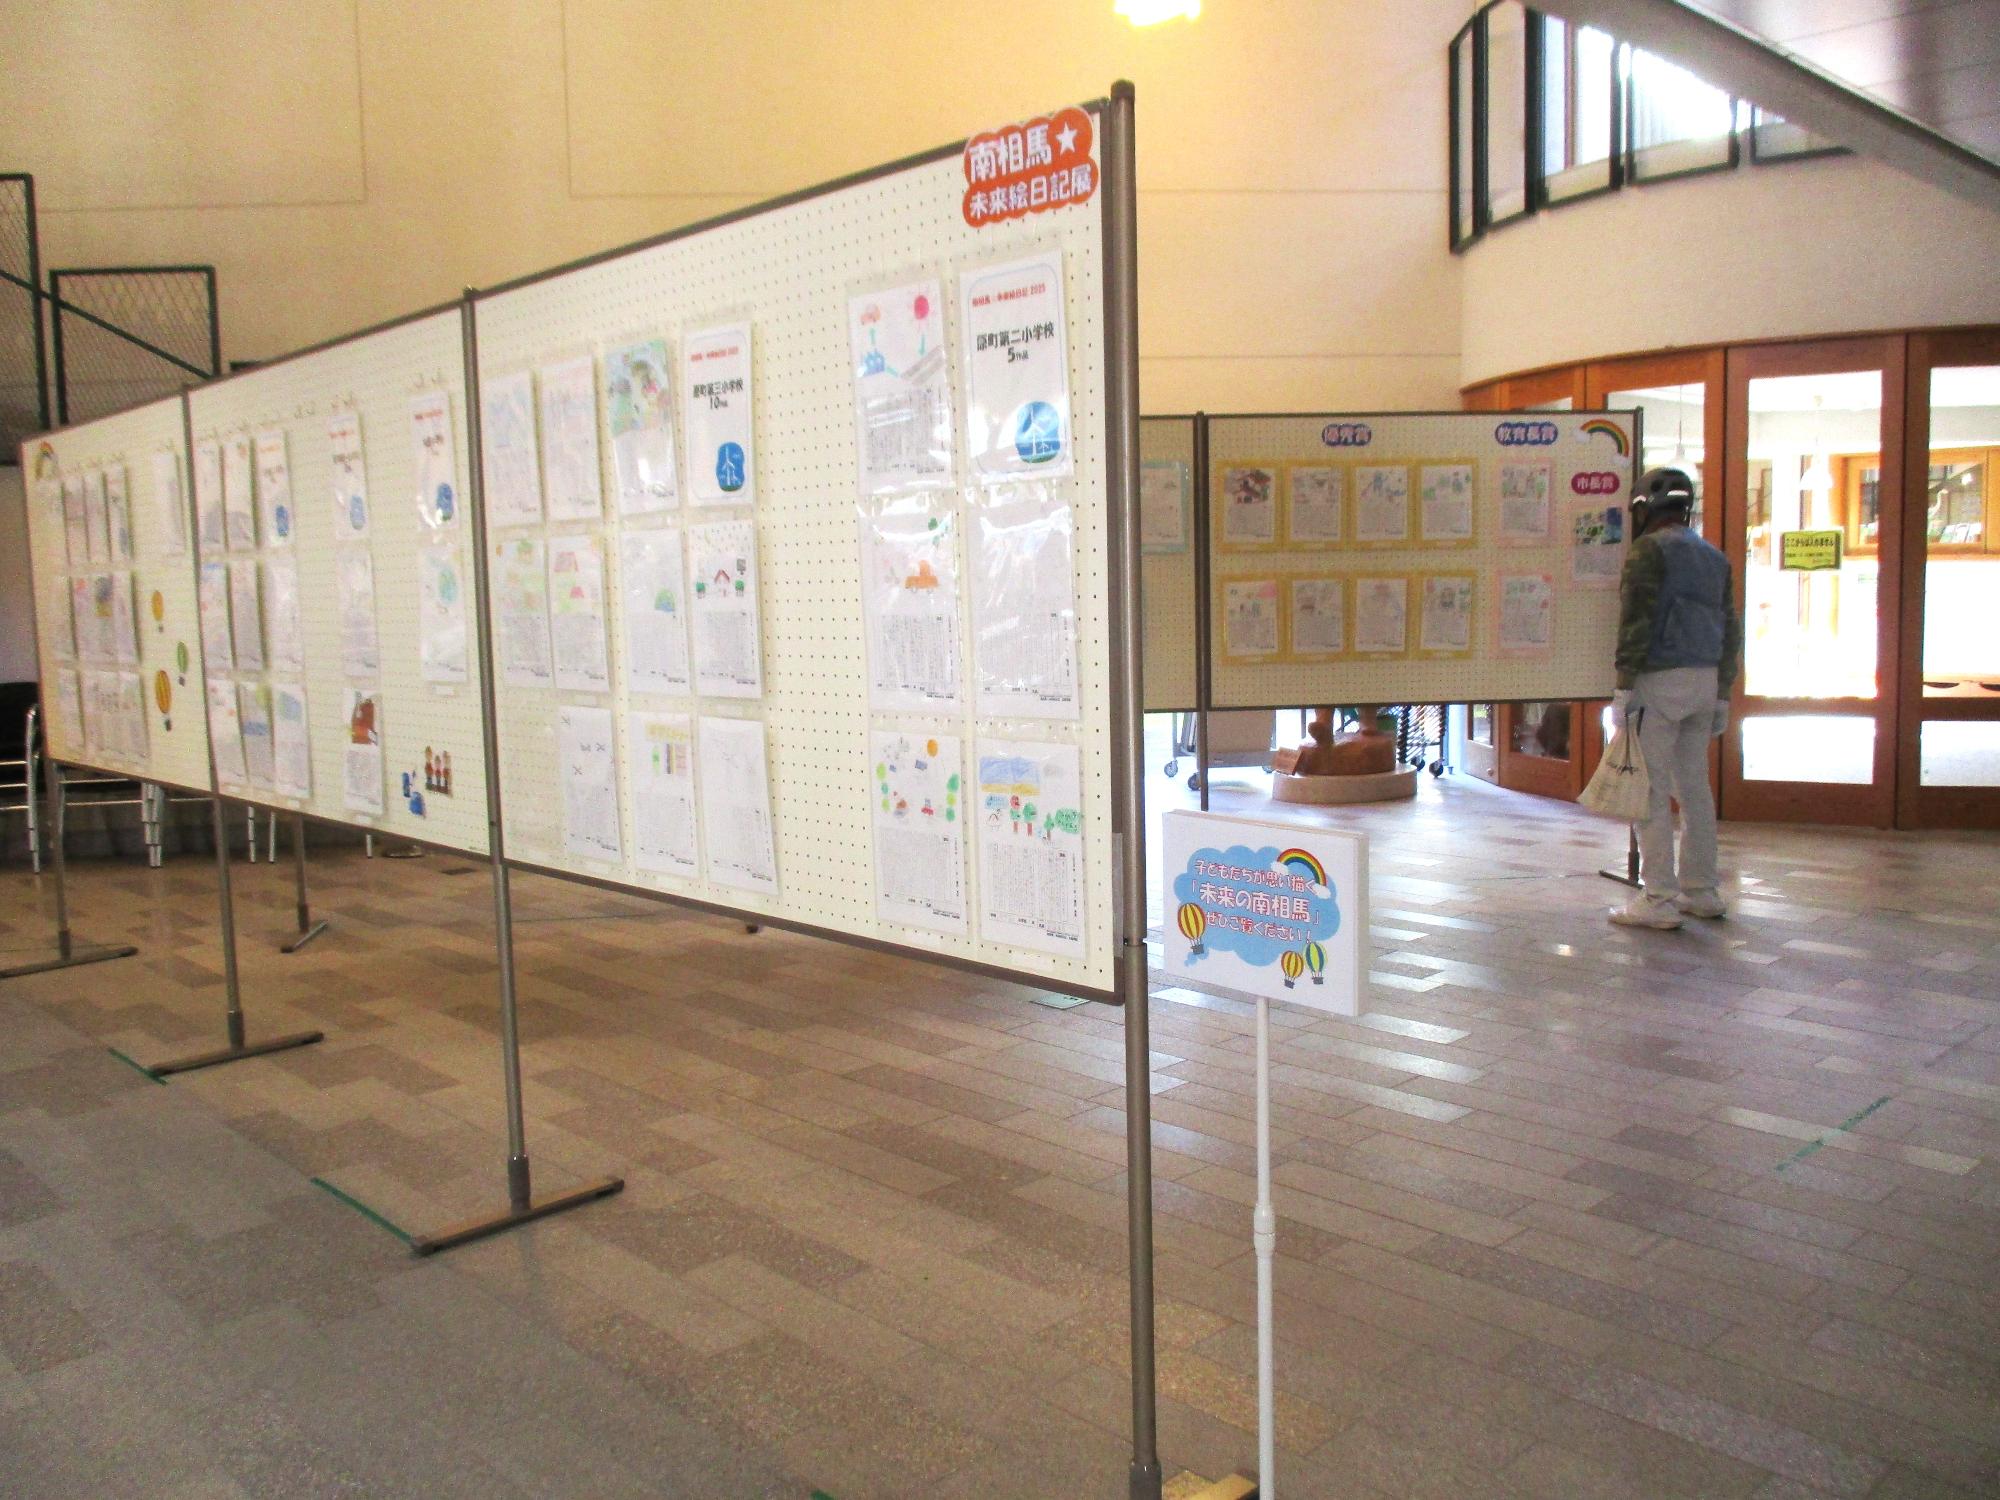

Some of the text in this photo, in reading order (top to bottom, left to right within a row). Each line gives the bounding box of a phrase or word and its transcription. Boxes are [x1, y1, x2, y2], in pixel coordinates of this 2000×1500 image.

[969, 124, 1052, 184] 南相馬
[970, 163, 1092, 220] 未来絵日記展
[976, 321, 1054, 352] 原町第二小学校
[1194, 860, 1317, 894] 子どもたちが思い描く
[1192, 879, 1320, 926] 「未来の南相馬」
